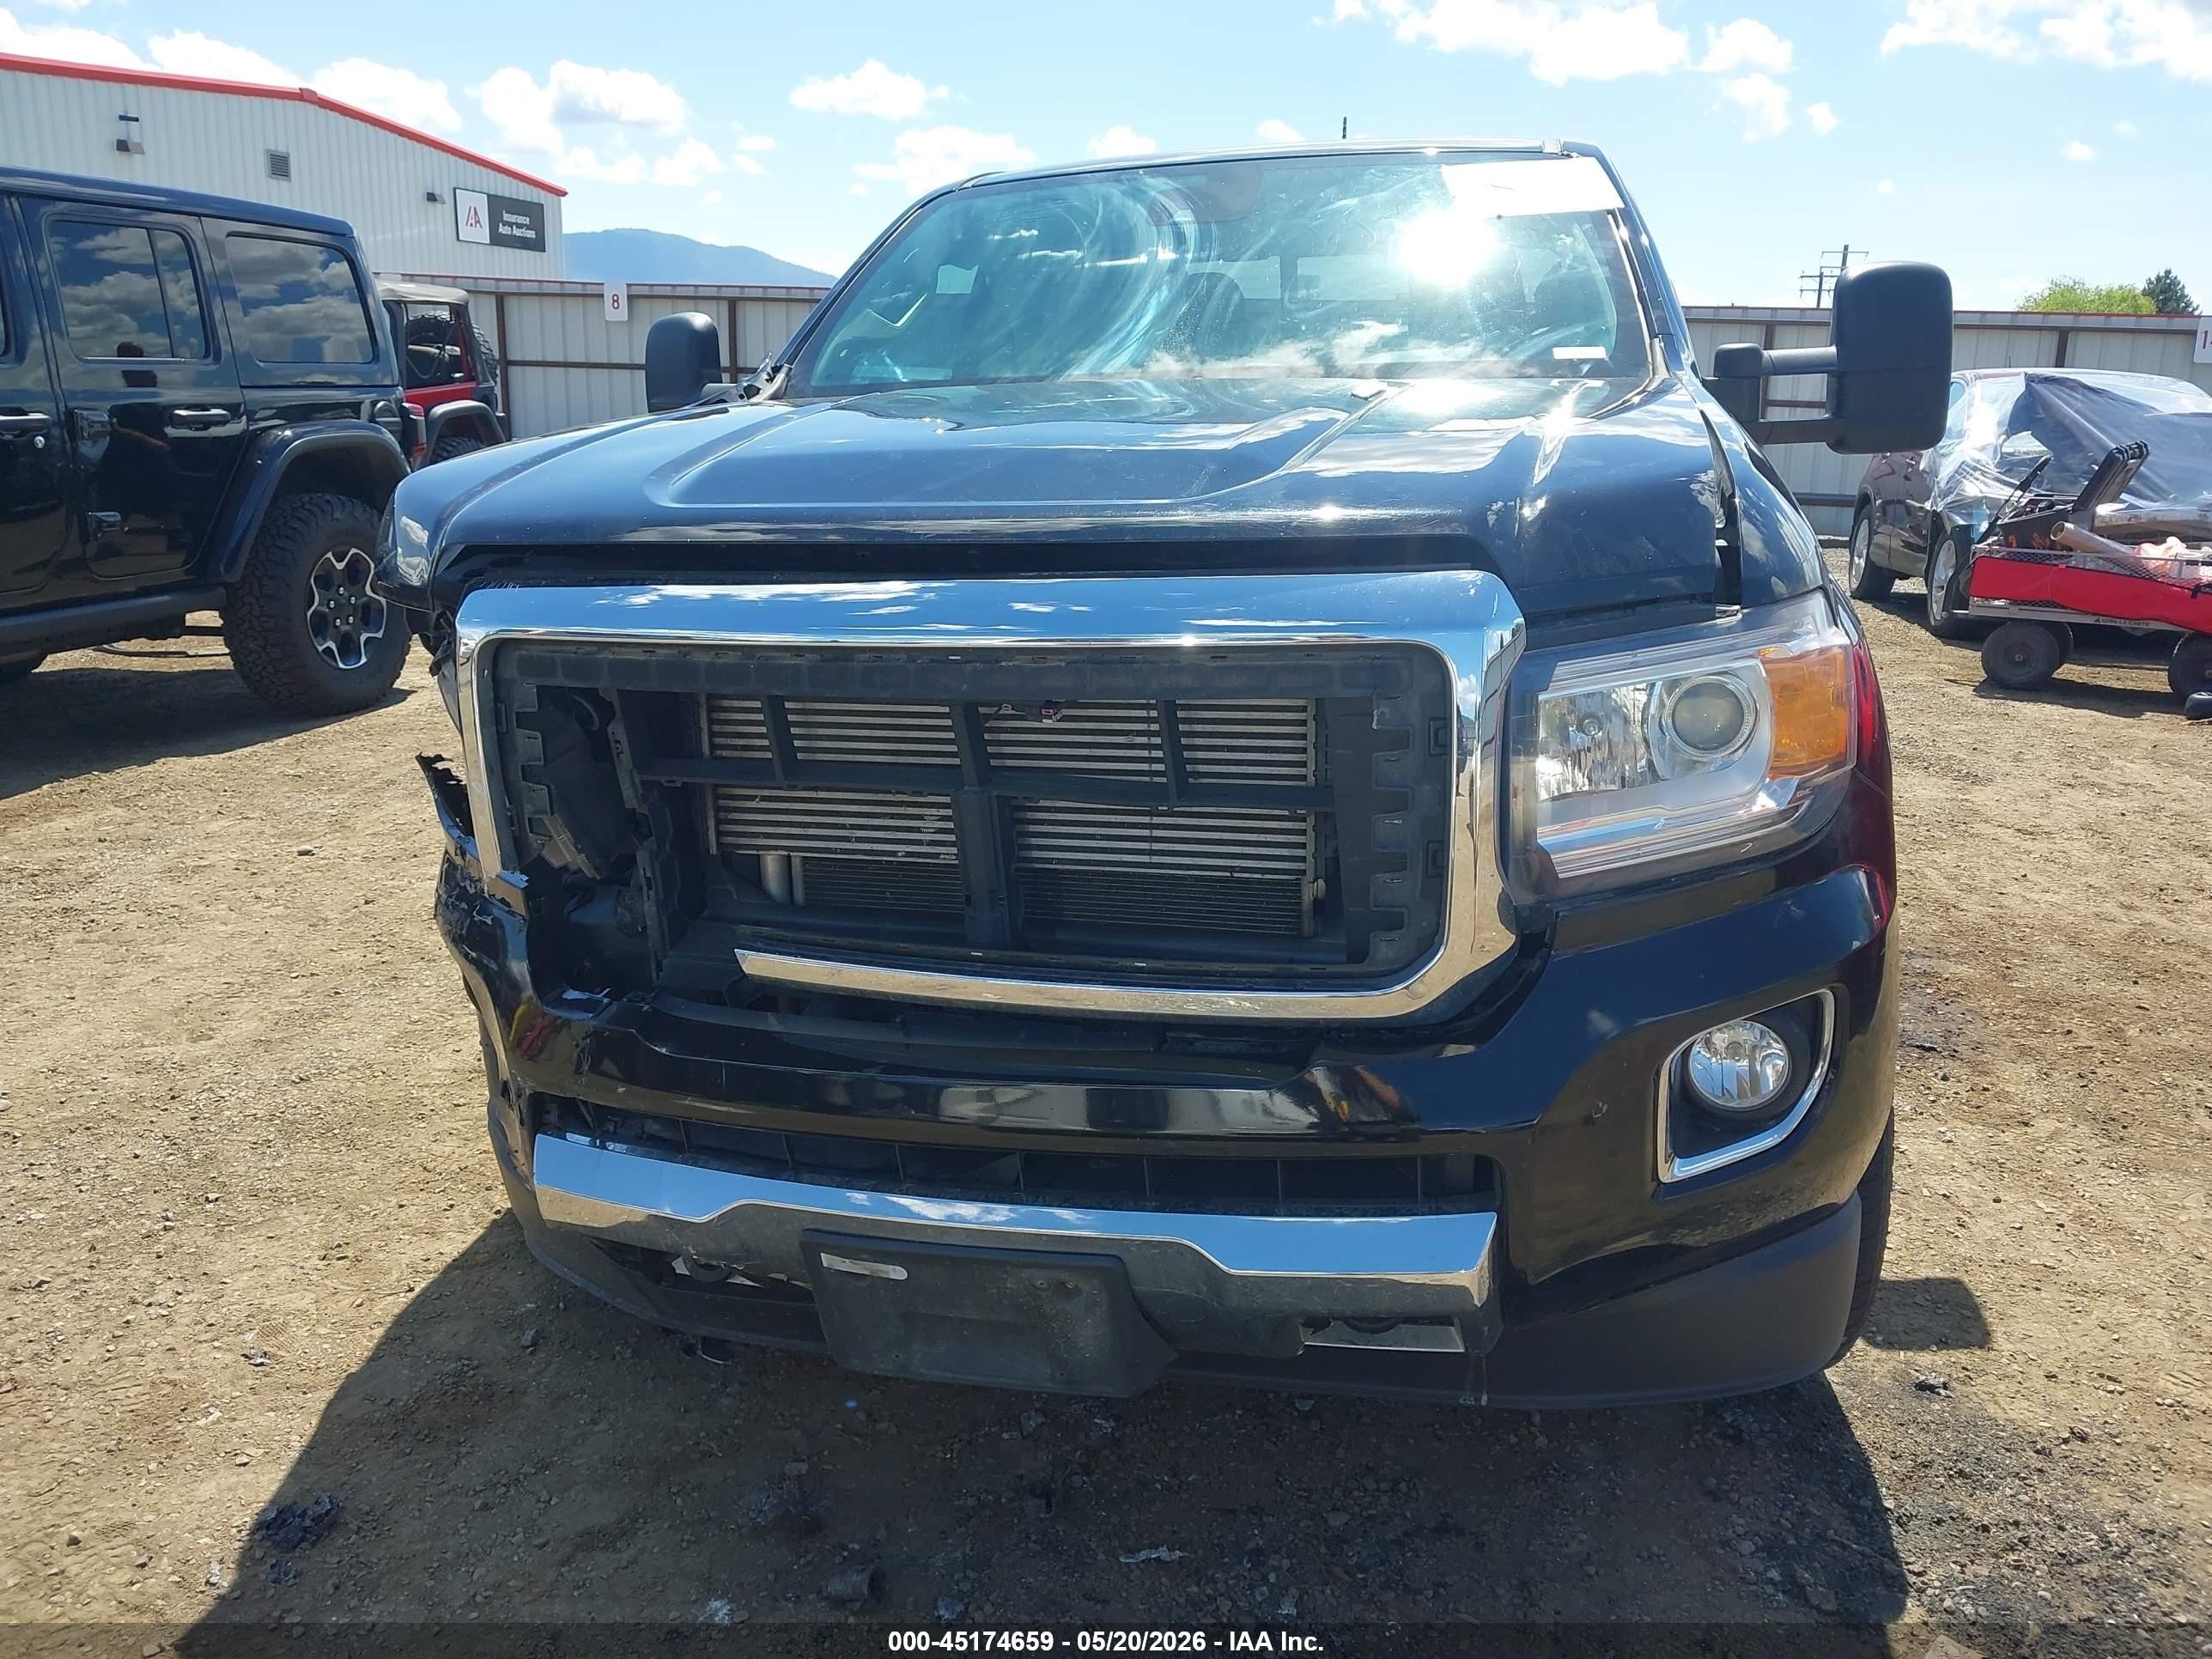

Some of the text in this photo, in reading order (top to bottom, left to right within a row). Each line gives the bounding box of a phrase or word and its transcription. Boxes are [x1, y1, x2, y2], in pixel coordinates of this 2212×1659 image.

[502, 210, 530, 225] Insurance
[498, 222, 537, 239] Auto Auctions
[611, 293, 620, 310] 8
[2203, 330, 2212, 350] 1
